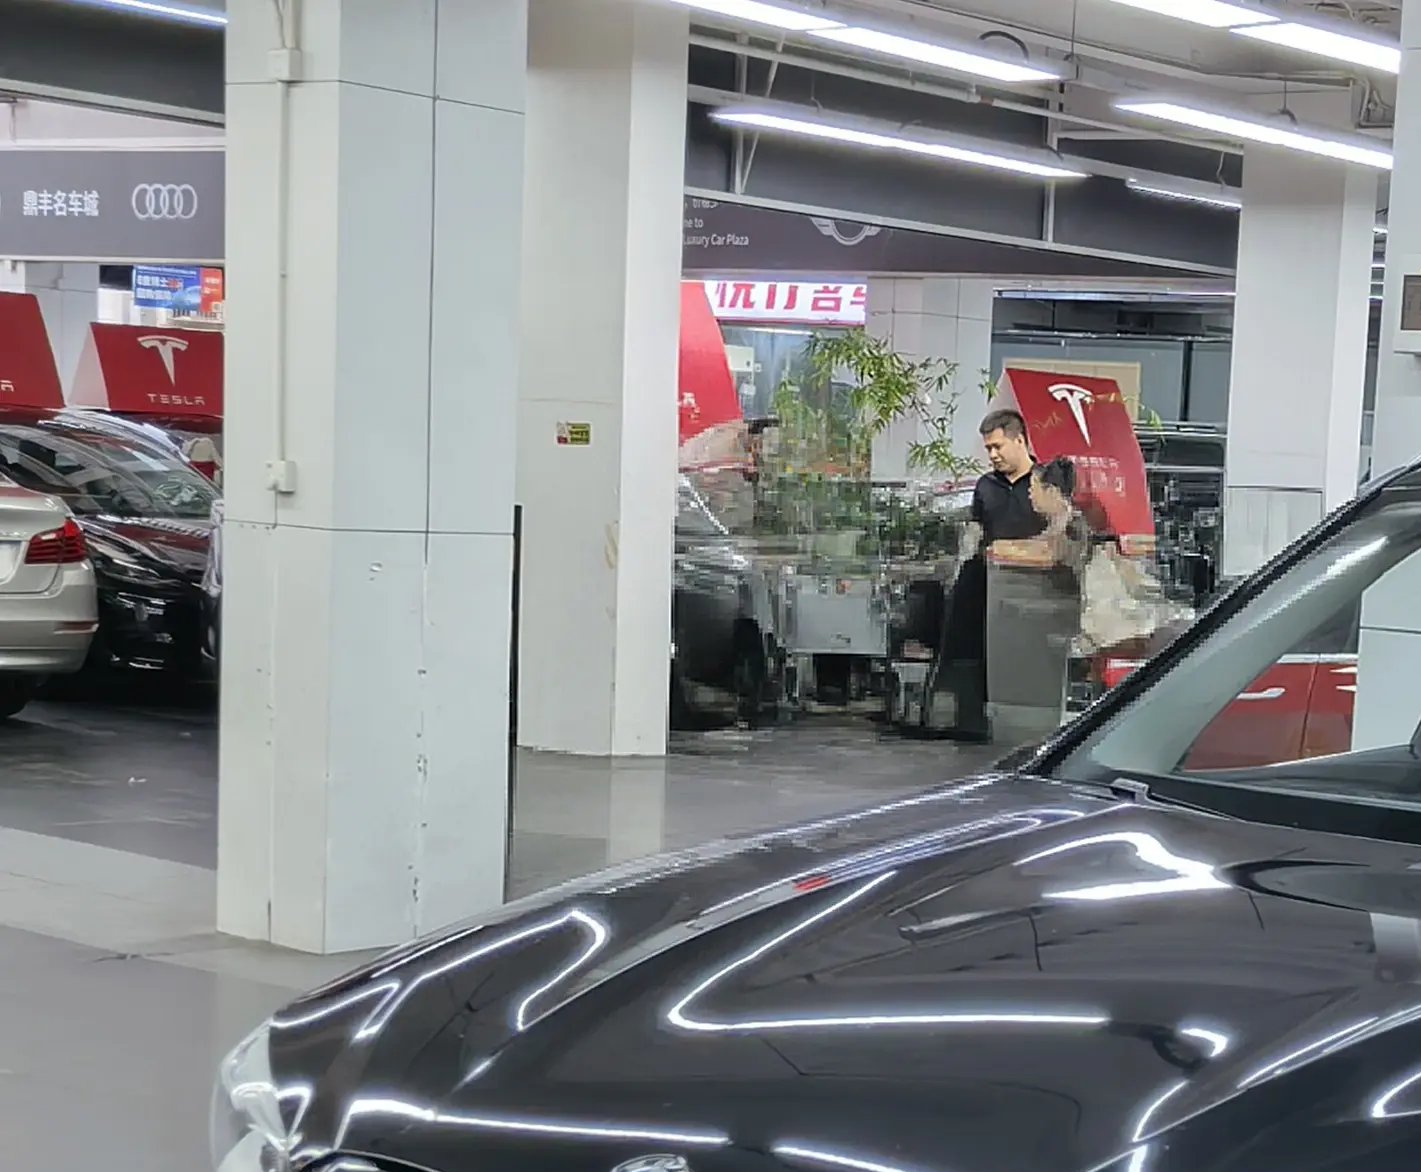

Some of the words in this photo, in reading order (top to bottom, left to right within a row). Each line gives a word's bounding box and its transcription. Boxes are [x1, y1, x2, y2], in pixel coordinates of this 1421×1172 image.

[694, 217, 704, 229] to
[710, 233, 726, 246] Car
[726, 233, 750, 246] Plaza
[147, 393, 206, 406] TESLA
